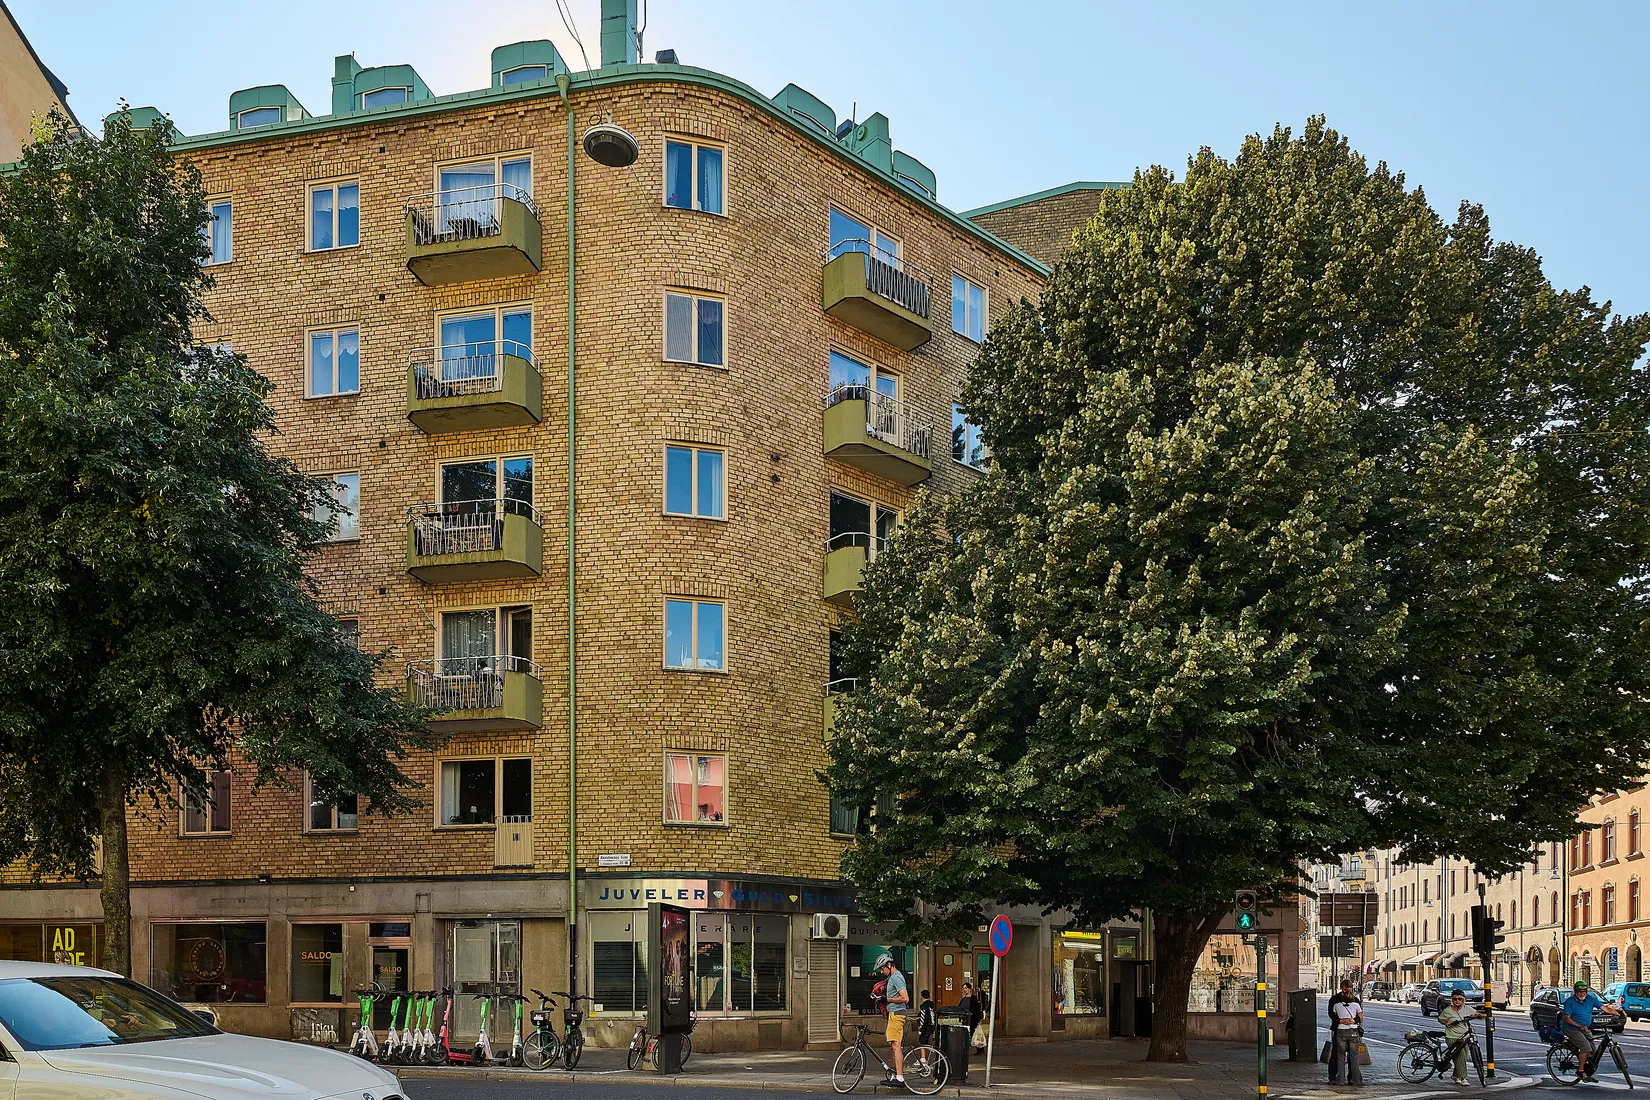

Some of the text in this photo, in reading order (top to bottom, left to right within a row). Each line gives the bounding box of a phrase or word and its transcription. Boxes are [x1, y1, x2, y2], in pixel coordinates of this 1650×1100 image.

[599, 887, 860, 909] JUVELER GULD SILVE
[52, 927, 75, 951] AD
[301, 951, 333, 960] SALDO
